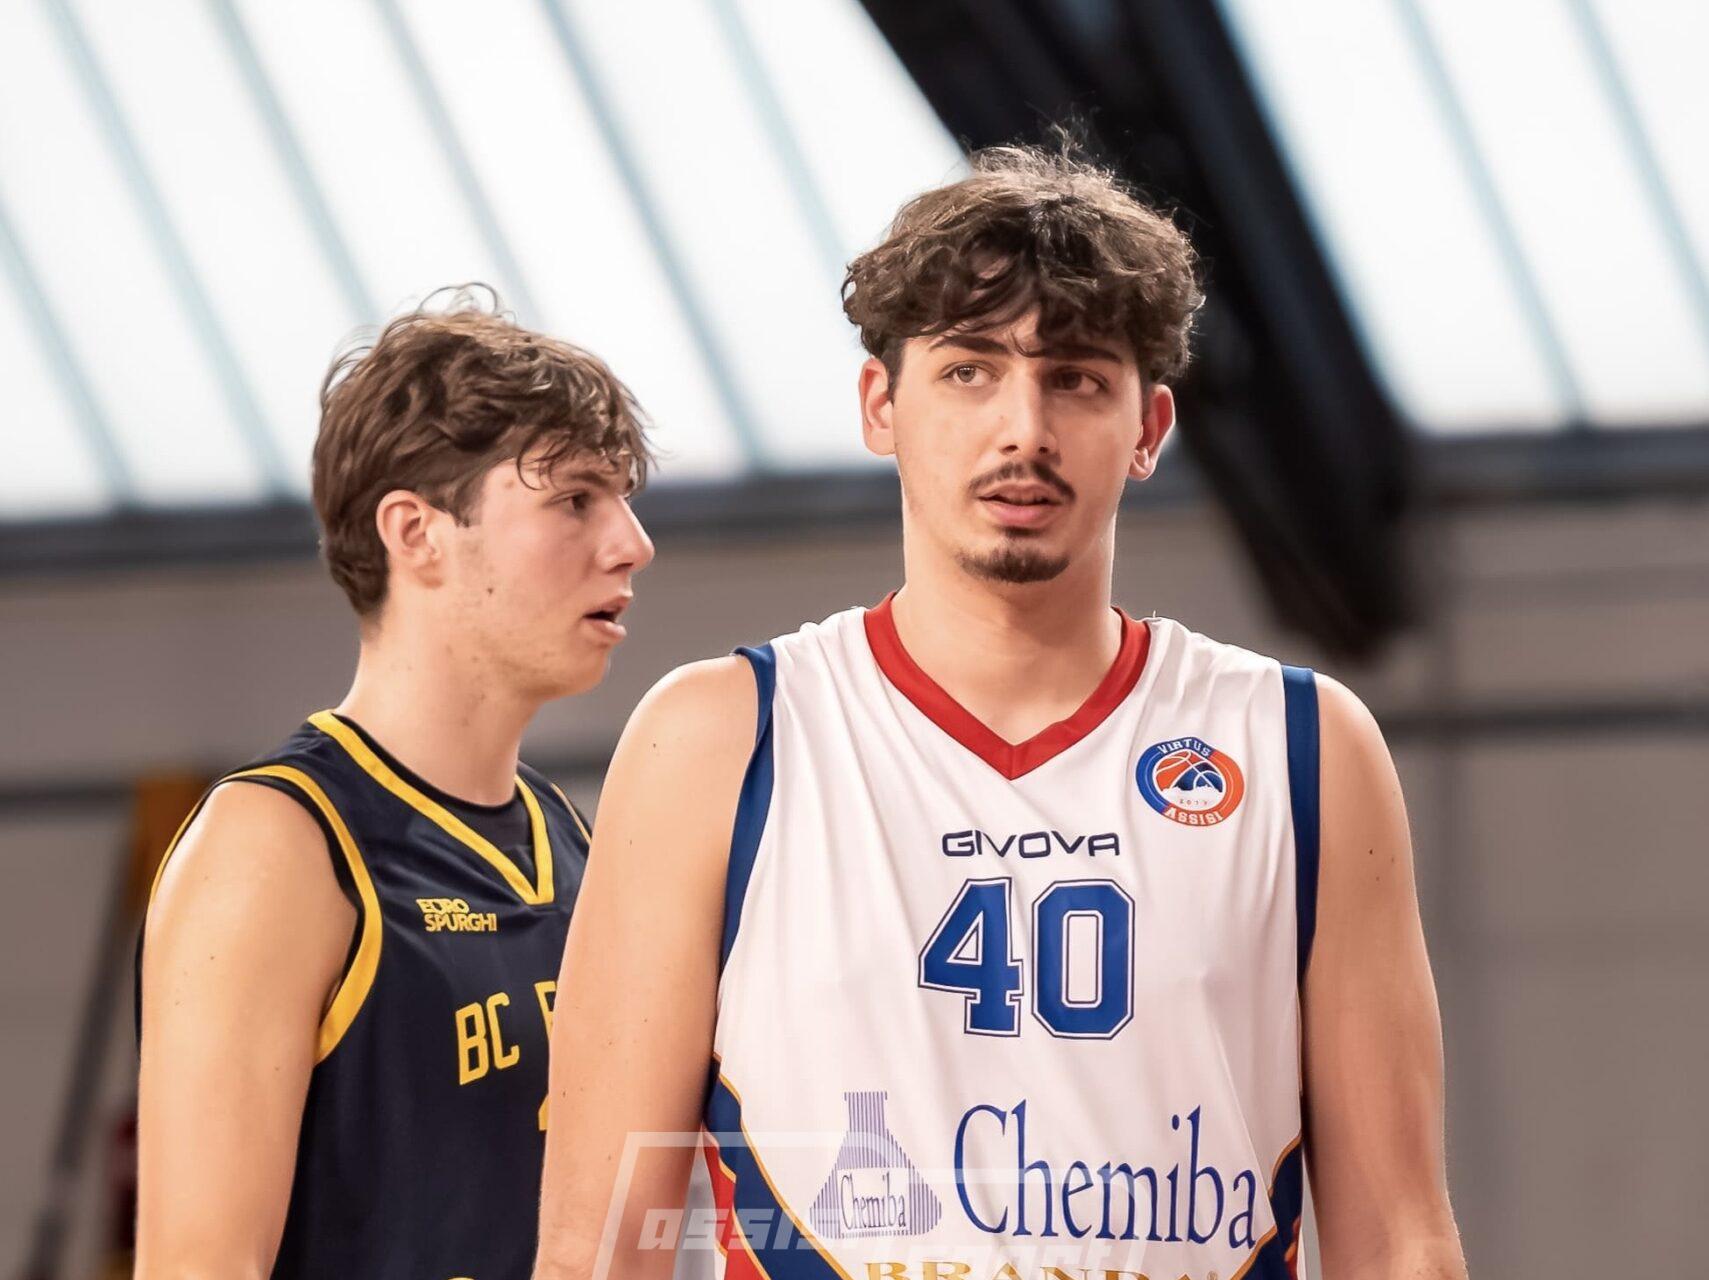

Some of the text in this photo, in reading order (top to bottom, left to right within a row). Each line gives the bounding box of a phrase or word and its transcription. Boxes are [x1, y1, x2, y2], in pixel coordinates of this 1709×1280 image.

[1157, 739, 1211, 757] VIRTUS
[1165, 807, 1223, 825] ASSISI
[942, 830, 1120, 858] GIVOVA
[424, 913, 497, 932] SPURGHI
[918, 876, 1135, 1041] 40
[455, 992, 520, 1085] BC
[953, 1100, 1257, 1249] Chemiba
[841, 1171, 906, 1230] Chemiba
